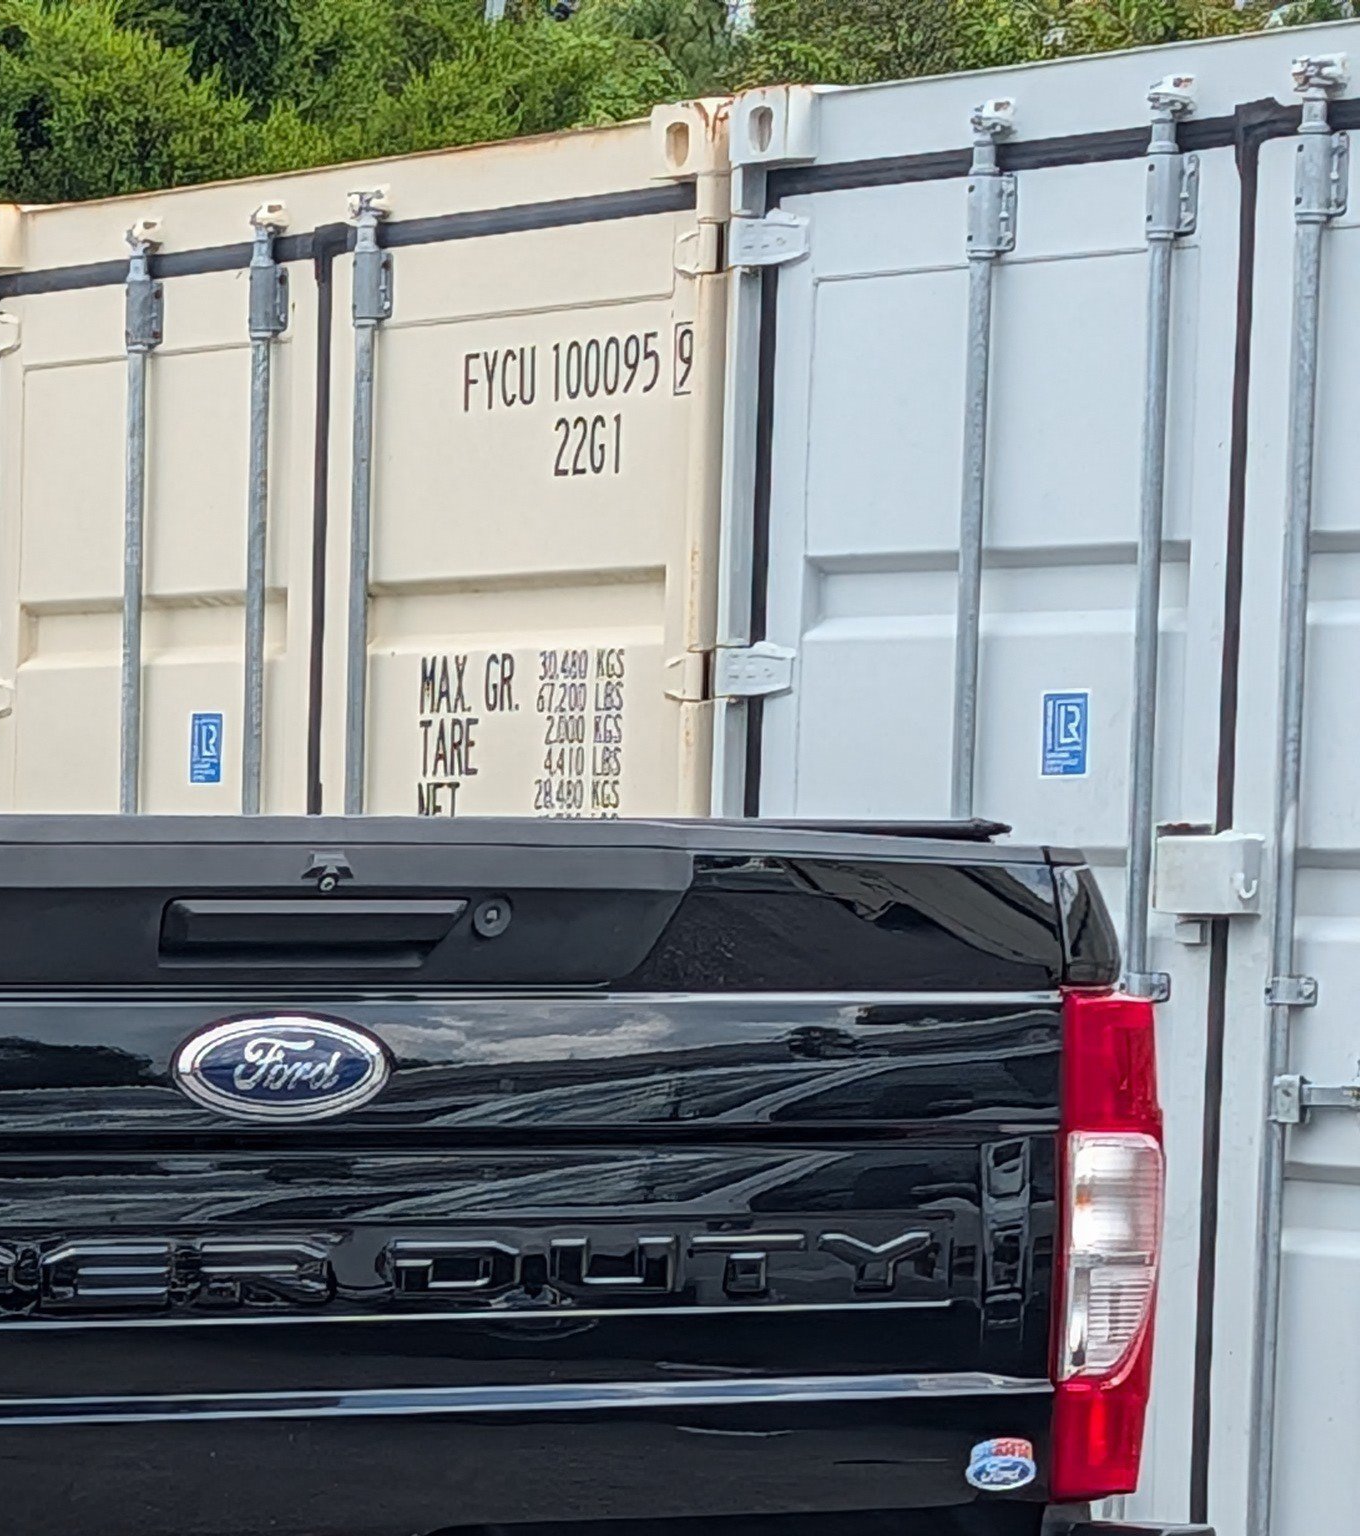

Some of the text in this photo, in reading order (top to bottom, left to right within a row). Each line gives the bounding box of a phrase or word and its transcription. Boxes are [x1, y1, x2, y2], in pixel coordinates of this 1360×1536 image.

[464, 328, 694, 411] FYCU 100095 9
[554, 413, 621, 476] 22G1
[420, 655, 472, 714] MAX.
[485, 653, 519, 712] GR.
[596, 649, 624, 678] KGS
[595, 681, 623, 711] LBS
[419, 718, 479, 777] TARE
[593, 714, 622, 743] KGS
[592, 746, 621, 776] LBS
[591, 780, 619, 809] KGS
[235, 1037, 342, 1091] Ford
[390, 1230, 934, 1296] DUTY
